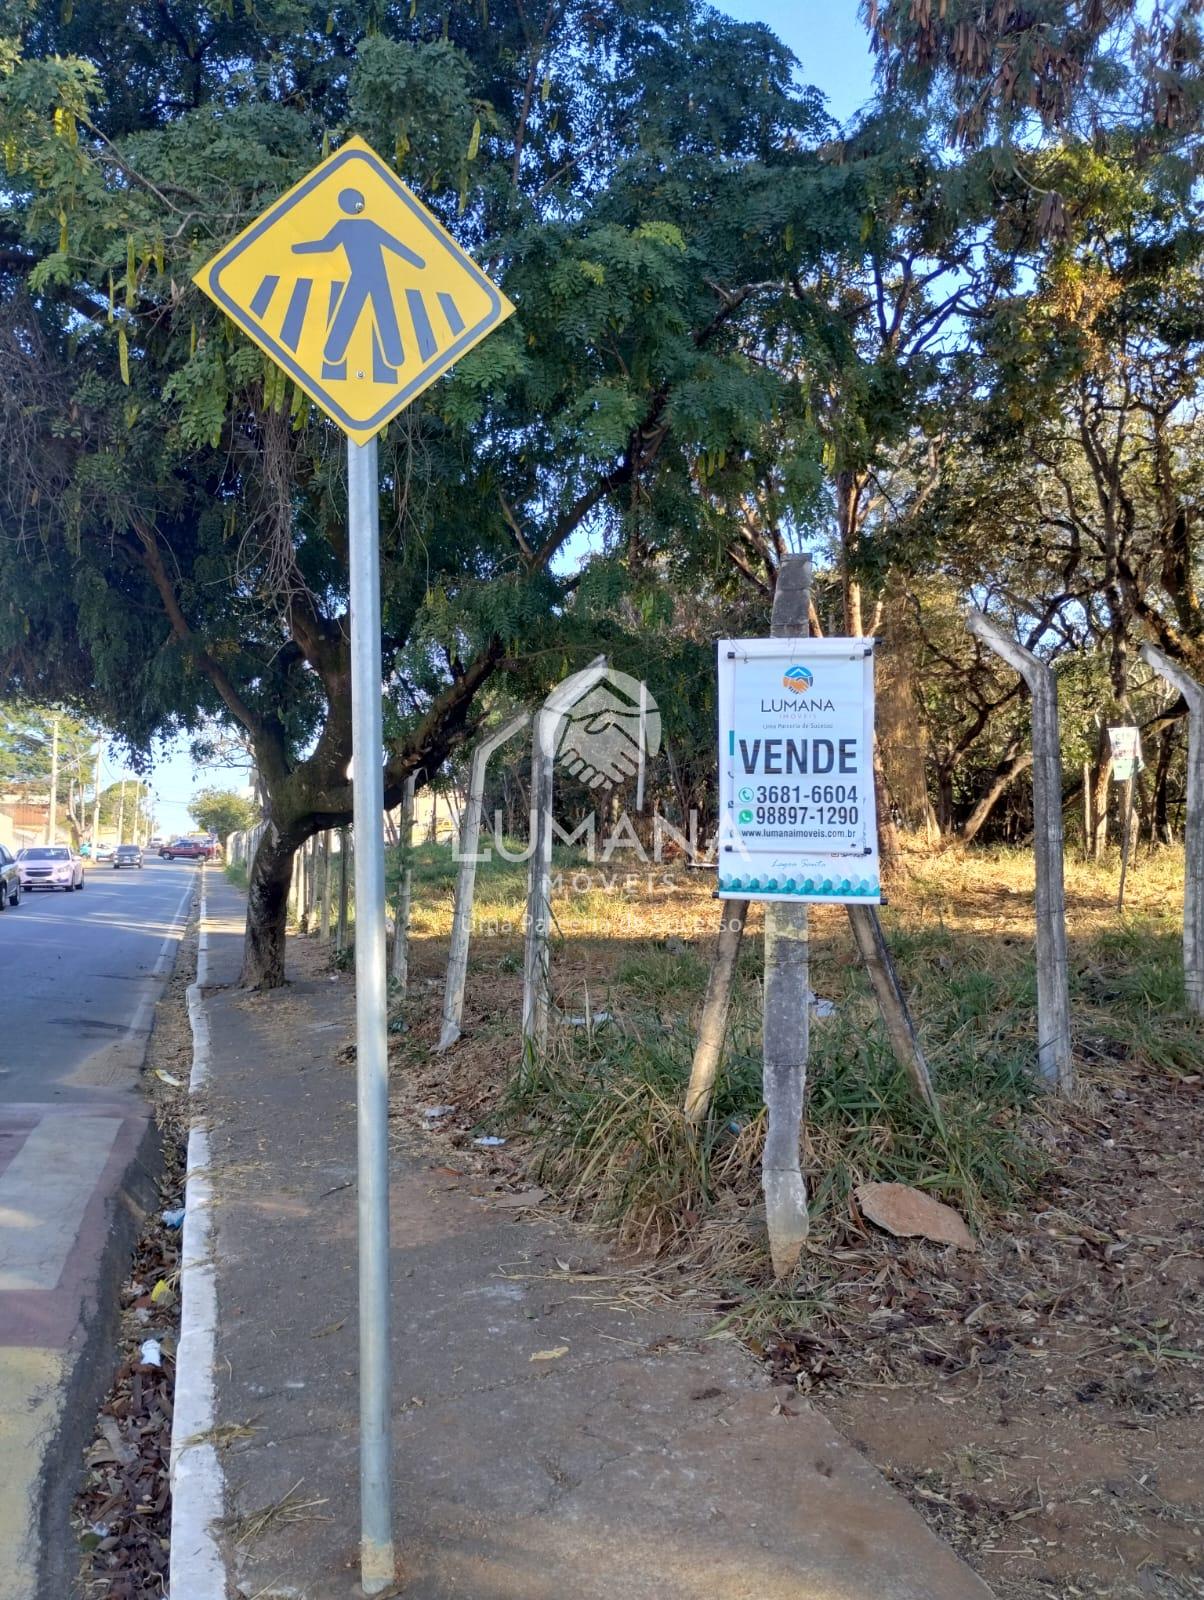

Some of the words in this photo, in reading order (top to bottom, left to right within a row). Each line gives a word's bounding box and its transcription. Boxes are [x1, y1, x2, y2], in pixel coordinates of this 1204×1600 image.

[761, 698, 836, 713] LUMANA
[738, 738, 858, 775] VENDE
[756, 785, 858, 804] 3681-6604
[756, 806, 859, 825] 98897-1290
[741, 828, 856, 838] www.lumanaimoveis.com.br
